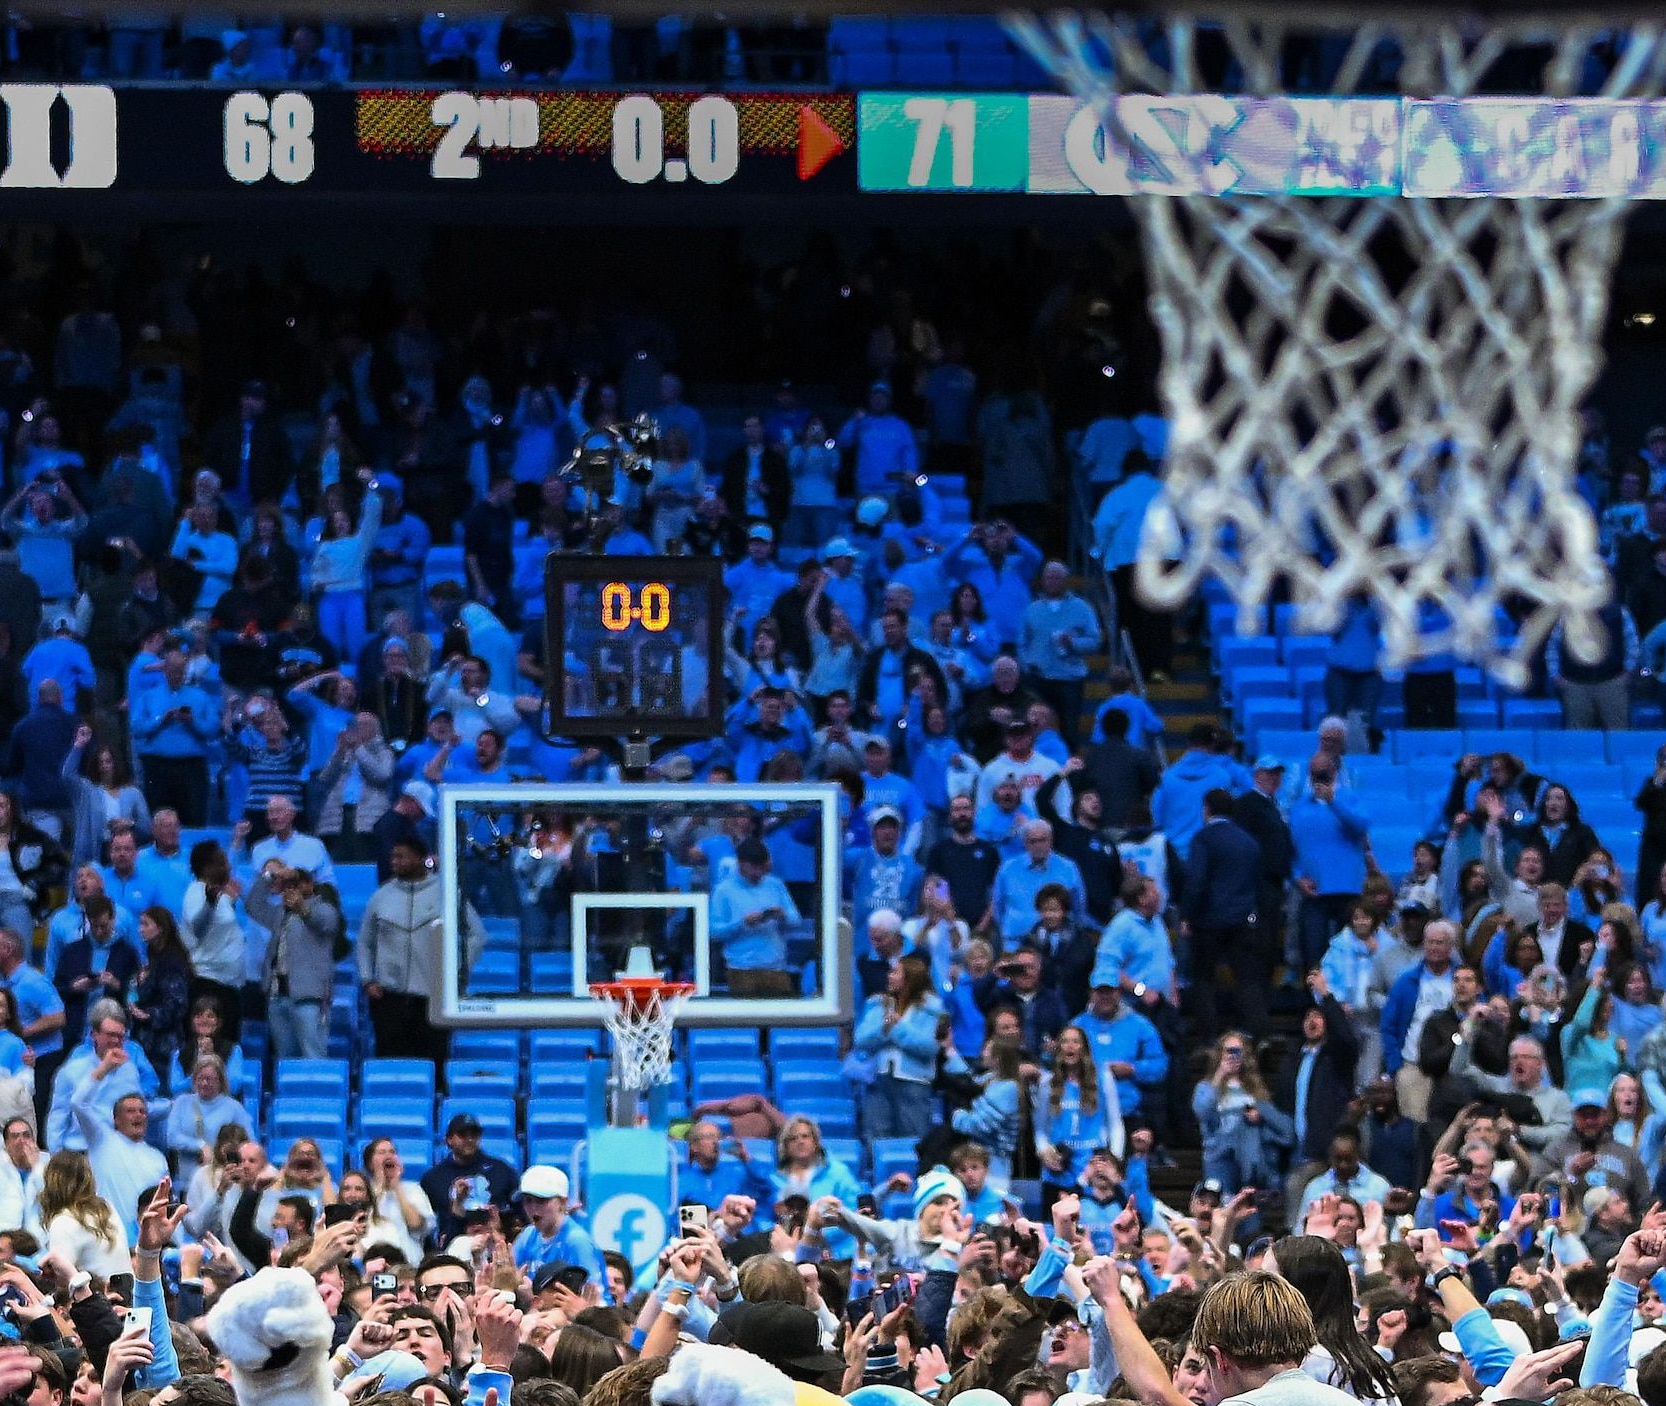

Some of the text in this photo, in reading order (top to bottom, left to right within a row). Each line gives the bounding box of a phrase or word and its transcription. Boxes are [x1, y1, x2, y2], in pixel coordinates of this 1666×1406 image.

[222, 91, 316, 185] 68
[611, 93, 740, 185] 0.0
[903, 97, 975, 188] 71
